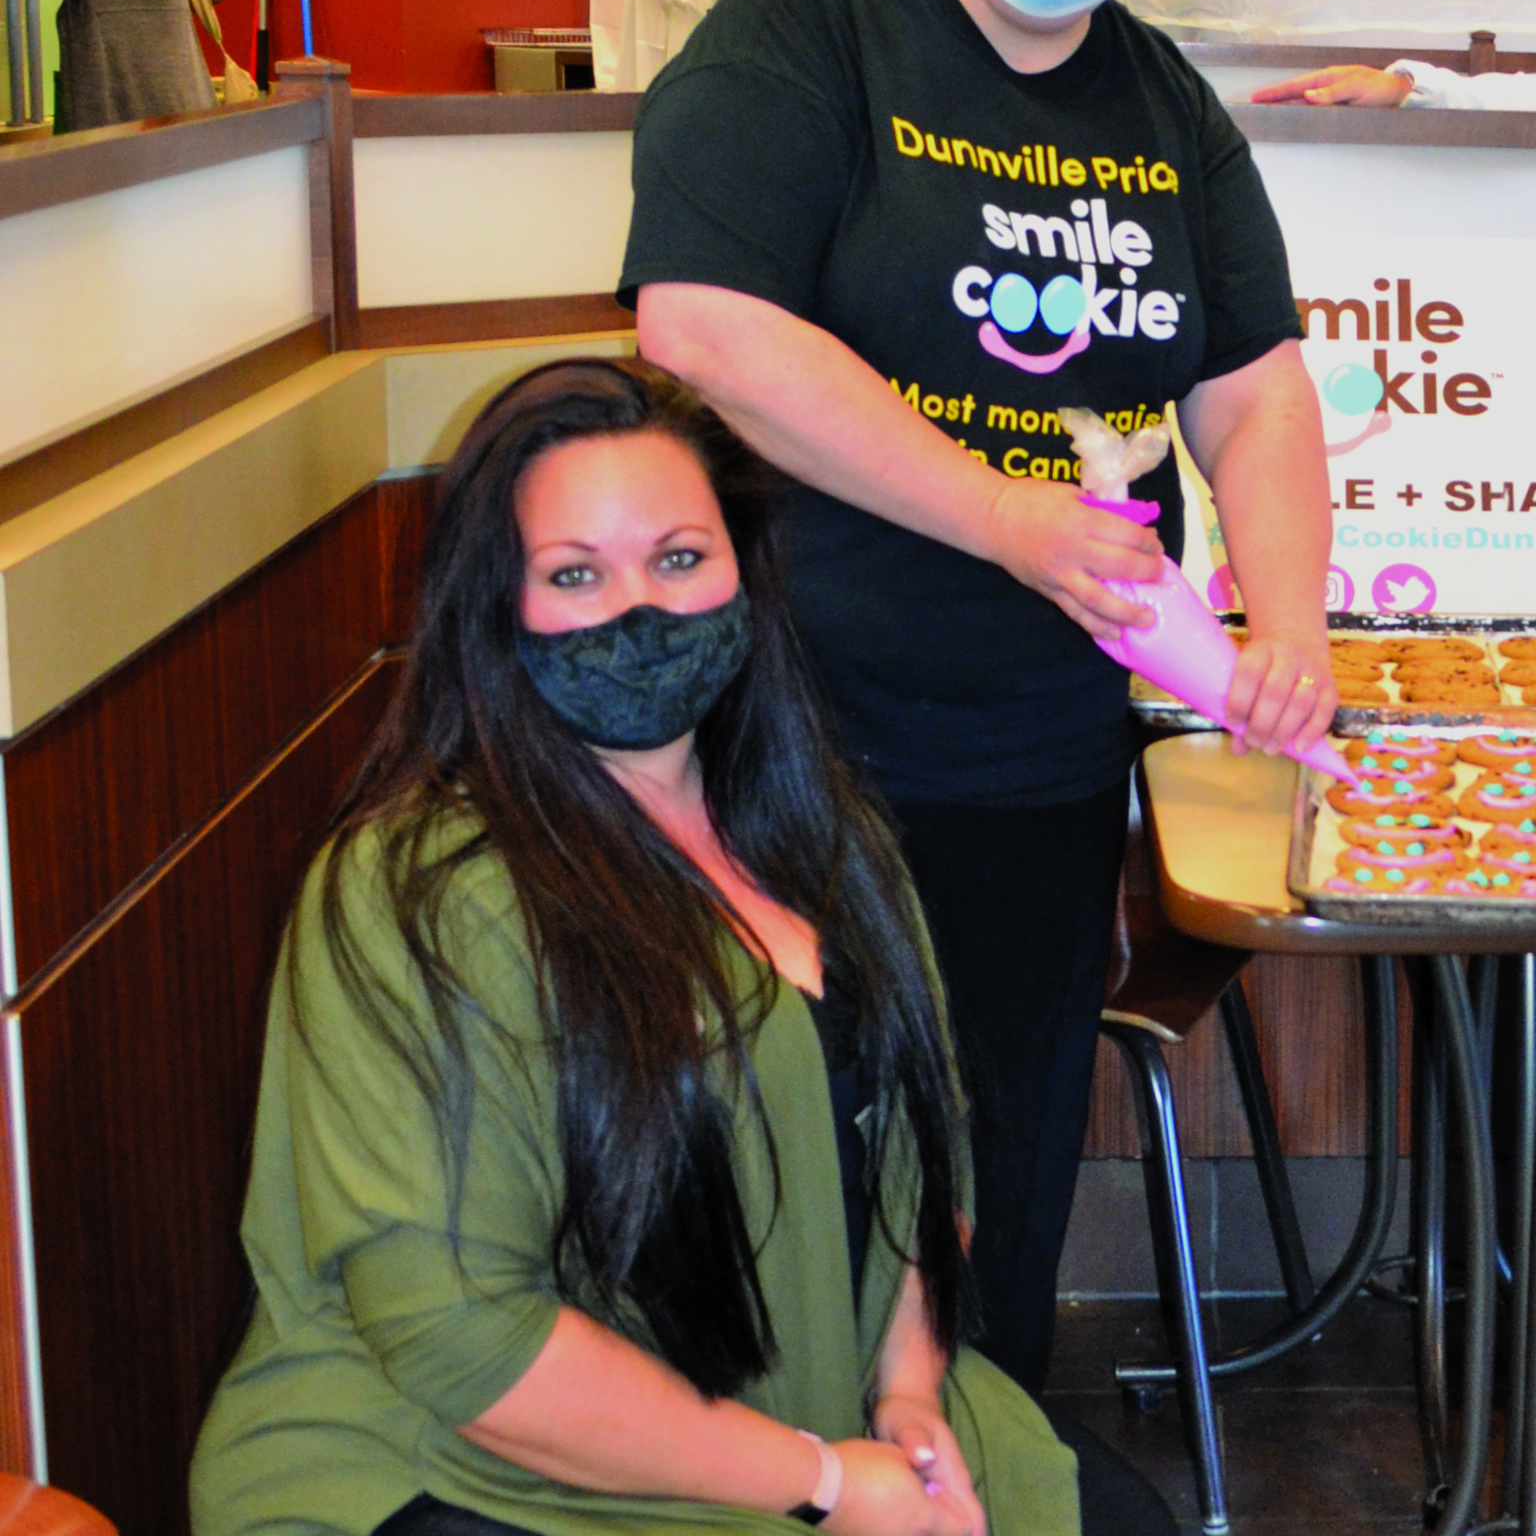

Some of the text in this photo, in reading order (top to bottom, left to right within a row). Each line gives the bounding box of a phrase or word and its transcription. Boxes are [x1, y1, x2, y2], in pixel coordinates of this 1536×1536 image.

[891, 116, 1087, 187] Dunnville
[982, 198, 1153, 267] smile
[952, 263, 1180, 341] cookie
[1293, 277, 1464, 344] mile
[1321, 348, 1493, 417] okie
[986, 403, 1072, 436] mon
